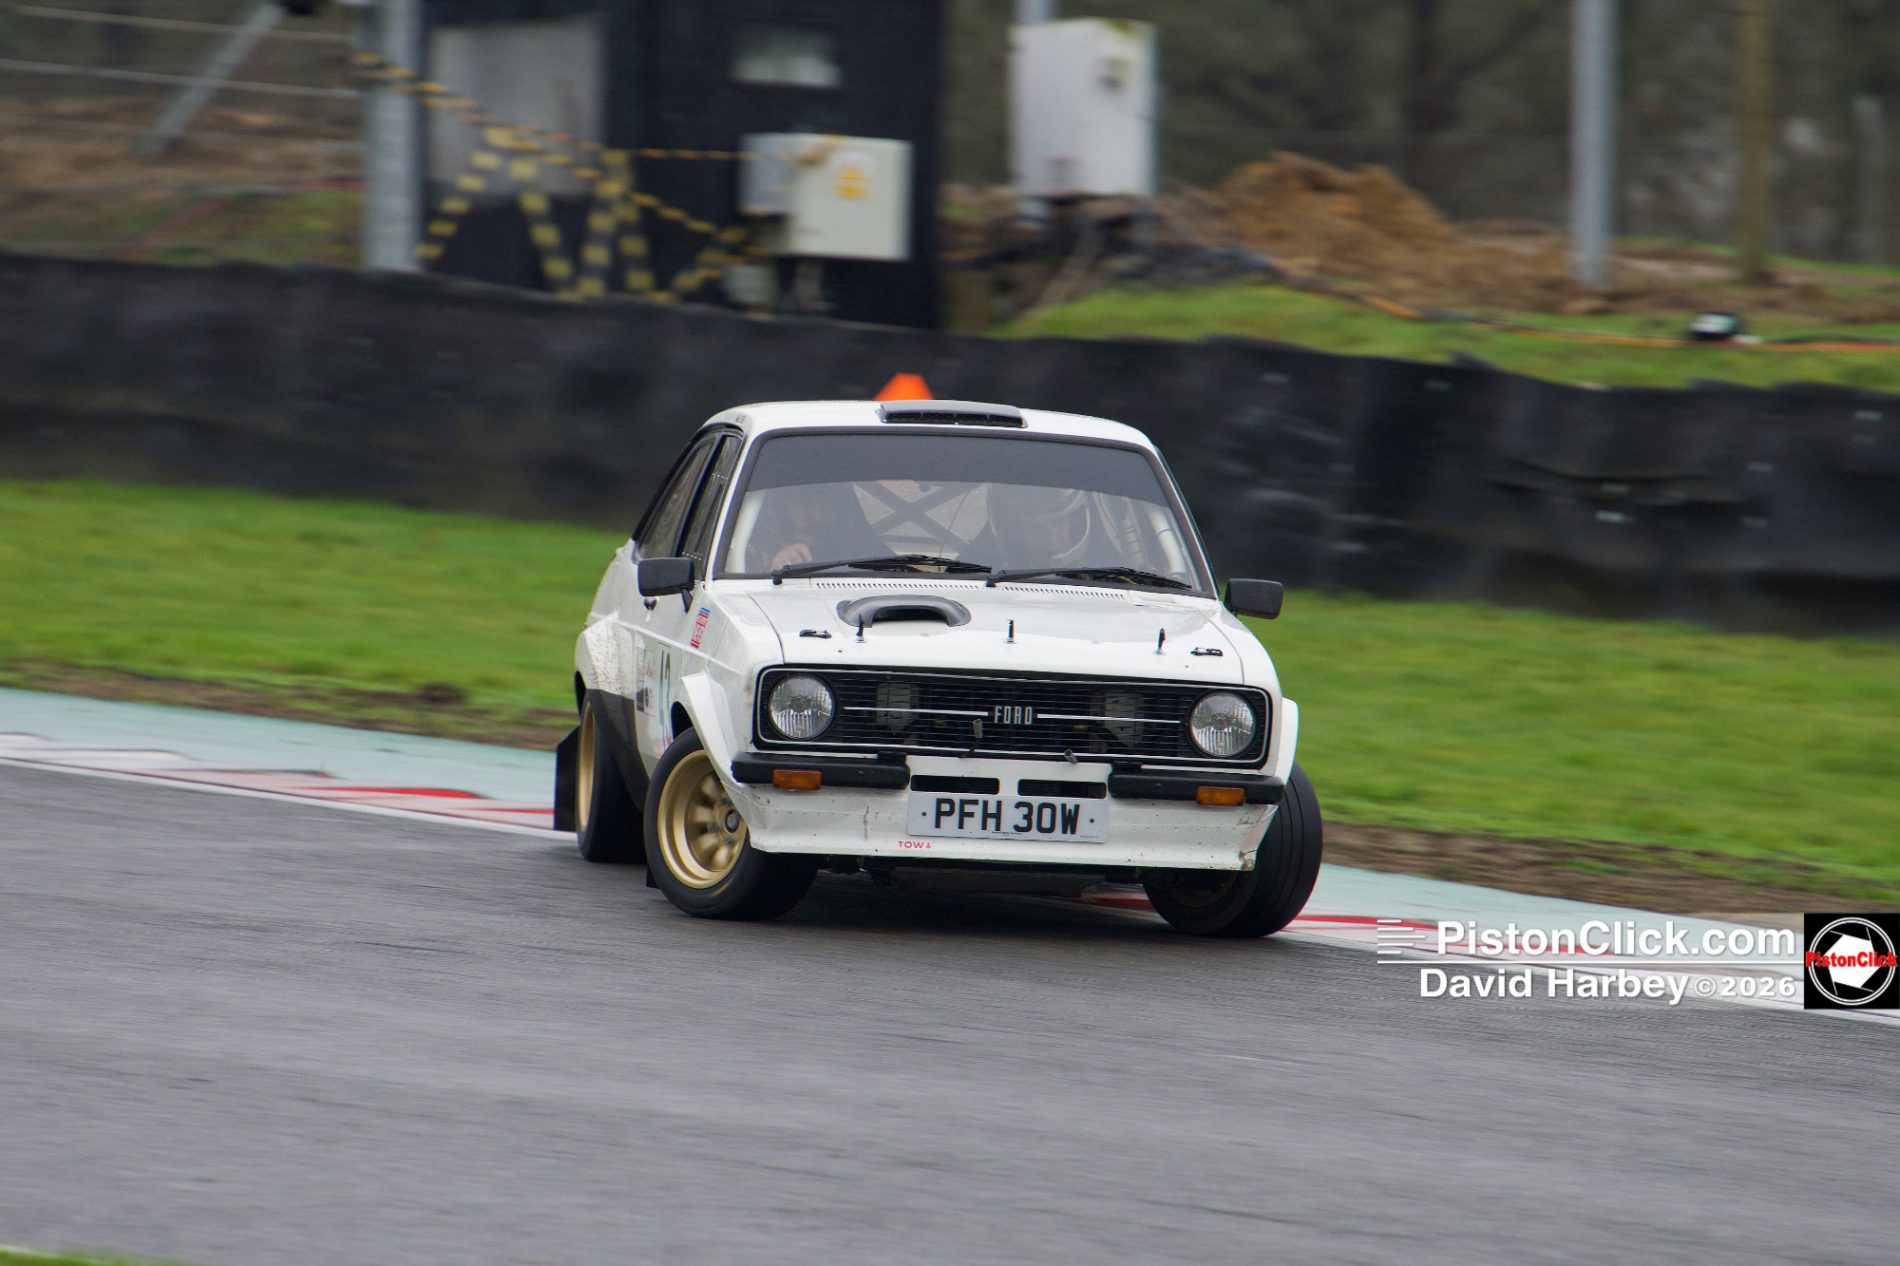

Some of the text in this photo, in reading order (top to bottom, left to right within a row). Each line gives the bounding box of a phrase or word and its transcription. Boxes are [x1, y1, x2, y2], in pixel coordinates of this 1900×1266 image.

[994, 705, 1033, 725] FORD
[934, 797, 1080, 835] PFH 30W
[898, 840, 925, 849] TOW
